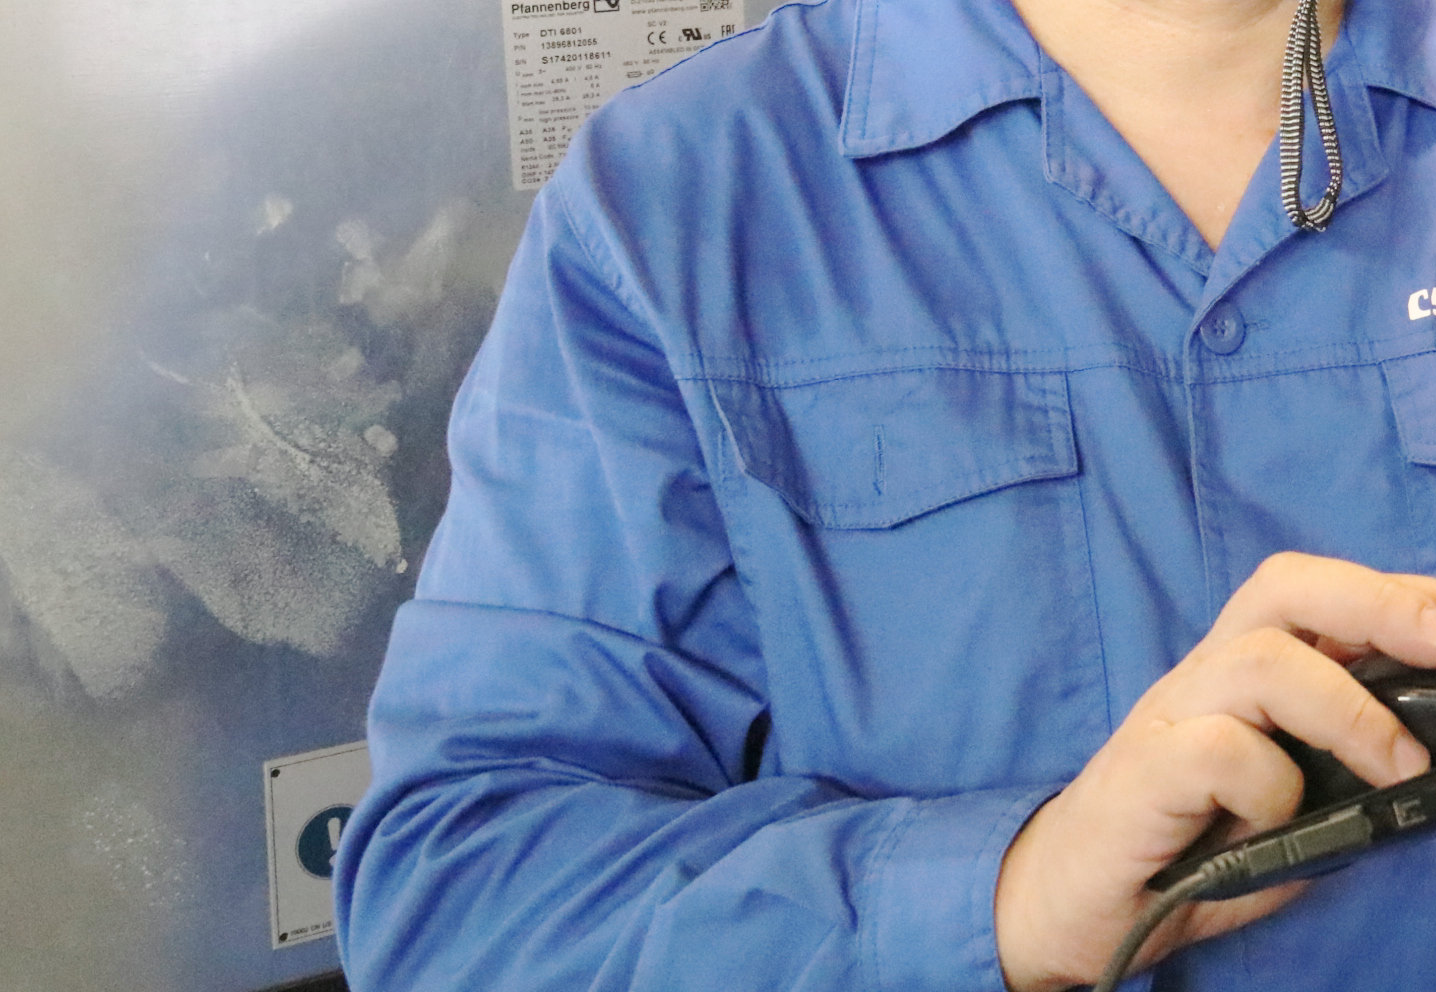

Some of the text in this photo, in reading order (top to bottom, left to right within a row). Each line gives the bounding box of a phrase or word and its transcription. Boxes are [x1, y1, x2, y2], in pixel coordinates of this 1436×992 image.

[511, 0, 590, 14] Pfannenberg
[513, 27, 582, 40] Type DTI 6801
[647, 30, 667, 45] CE
[541, 51, 612, 64] S17420118611
